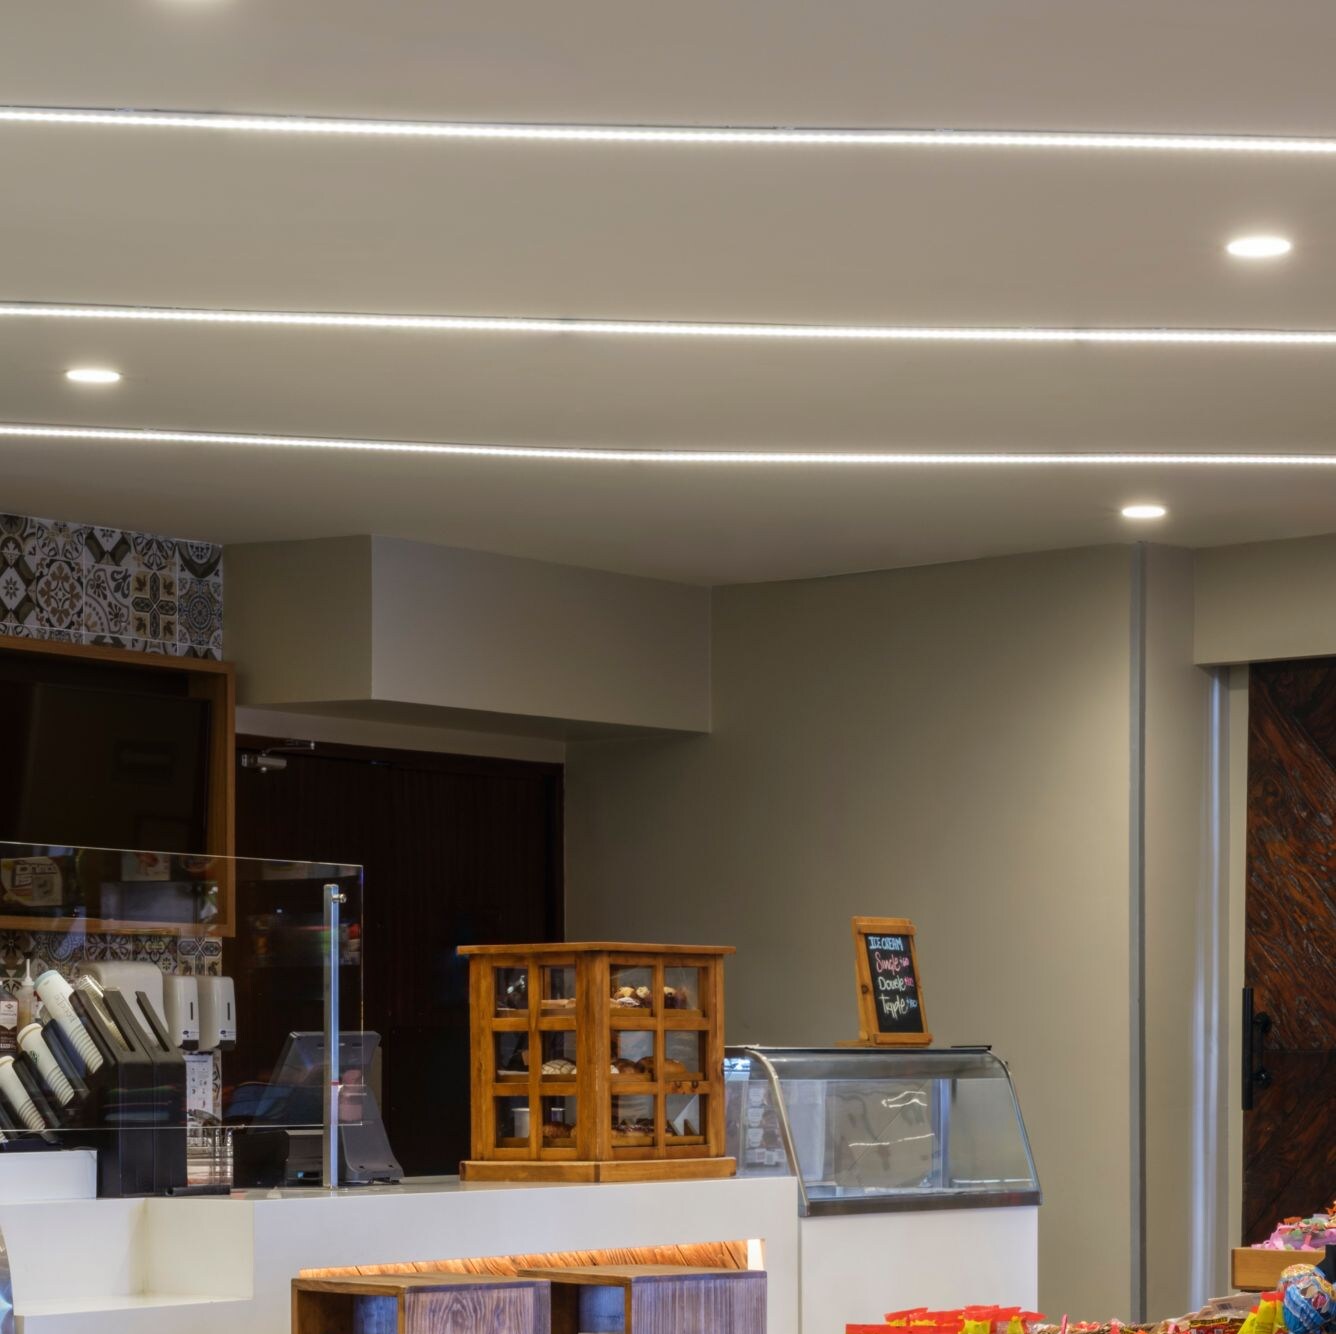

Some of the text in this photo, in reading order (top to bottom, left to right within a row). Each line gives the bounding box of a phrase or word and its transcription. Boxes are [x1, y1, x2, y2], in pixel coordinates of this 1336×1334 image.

[868, 936, 904, 951] ICE CREAM
[876, 953, 901, 974] Single
[879, 977, 906, 991] Double
[879, 994, 908, 1019] Triple
